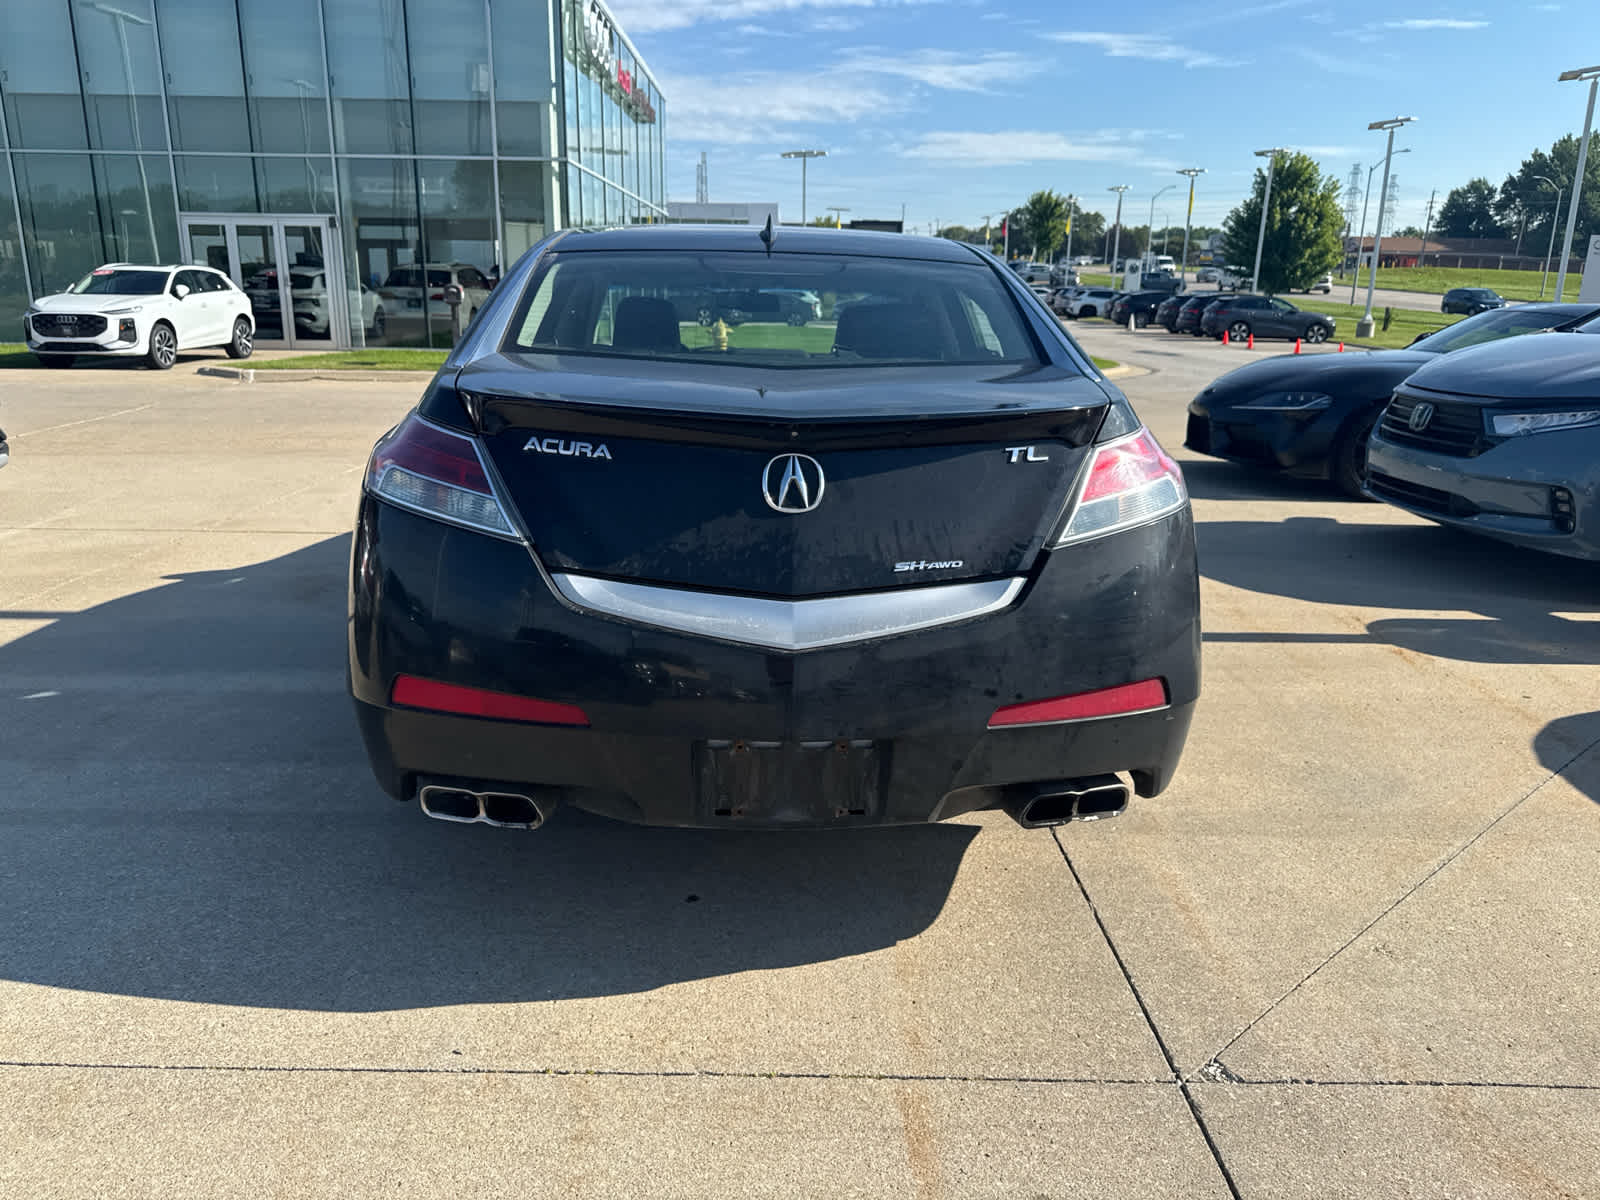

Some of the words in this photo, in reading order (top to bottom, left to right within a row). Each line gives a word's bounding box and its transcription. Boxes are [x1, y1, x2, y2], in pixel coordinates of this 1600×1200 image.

[522, 435, 613, 460] ACURA
[1004, 446, 1050, 463] TL
[893, 559, 964, 573] SH-AWD
